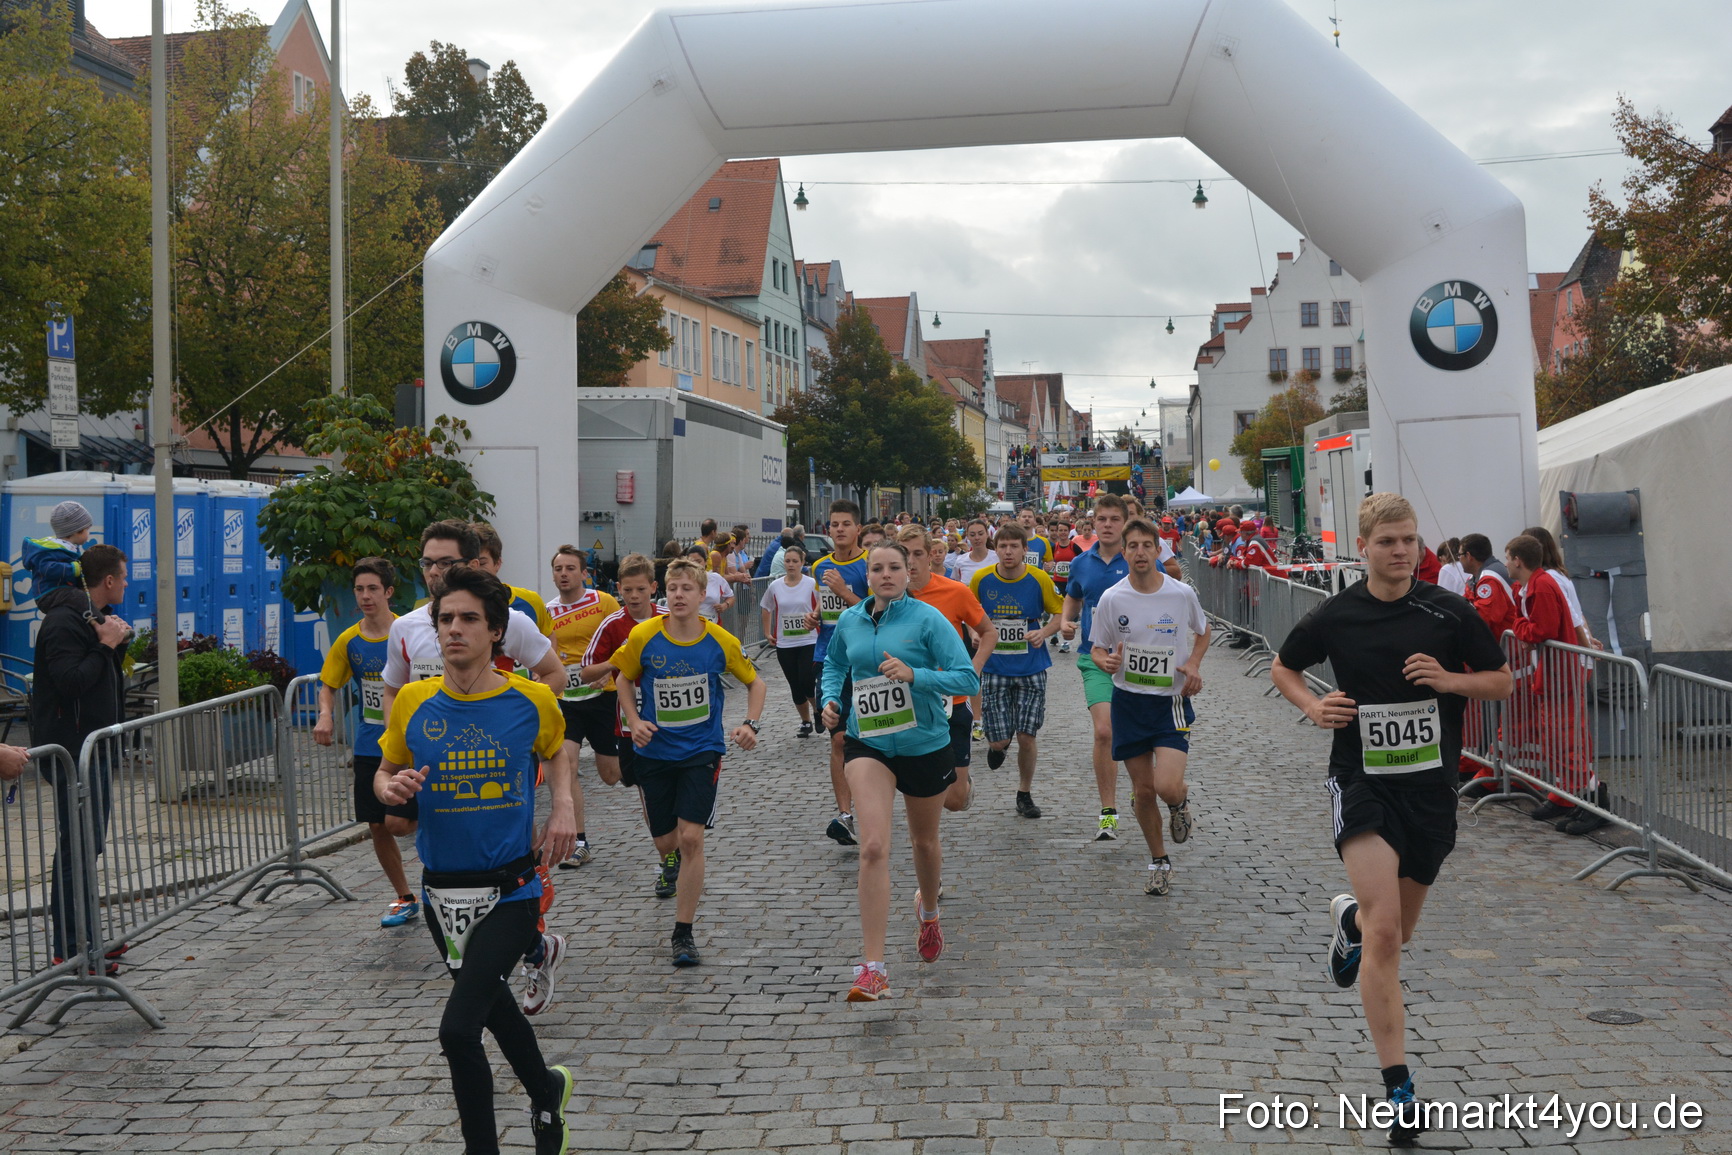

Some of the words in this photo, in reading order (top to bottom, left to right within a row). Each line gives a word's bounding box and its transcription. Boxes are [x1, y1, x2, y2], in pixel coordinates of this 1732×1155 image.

[1416, 282, 1491, 313] BMW
[445, 323, 510, 350] BMW
[1070, 469, 1102, 478] START
[574, 606, 603, 621] BÖGL
[1128, 654, 1169, 674] 5021
[671, 680, 699, 688] Neumarkt
[869, 680, 896, 690] Neumarkt
[1138, 676, 1156, 685] Hans
[658, 686, 705, 709] 5519
[858, 686, 906, 715] 5079
[1360, 711, 1387, 719] PARTL
[1388, 708, 1425, 718] Neumarkt
[873, 716, 895, 728] Tanja
[1368, 717, 1434, 747] 5045
[1386, 751, 1419, 764] Daniel
[435, 801, 523, 813] www.stadtlauf-neumarkt.de
[444, 896, 485, 905] Neumarkt
